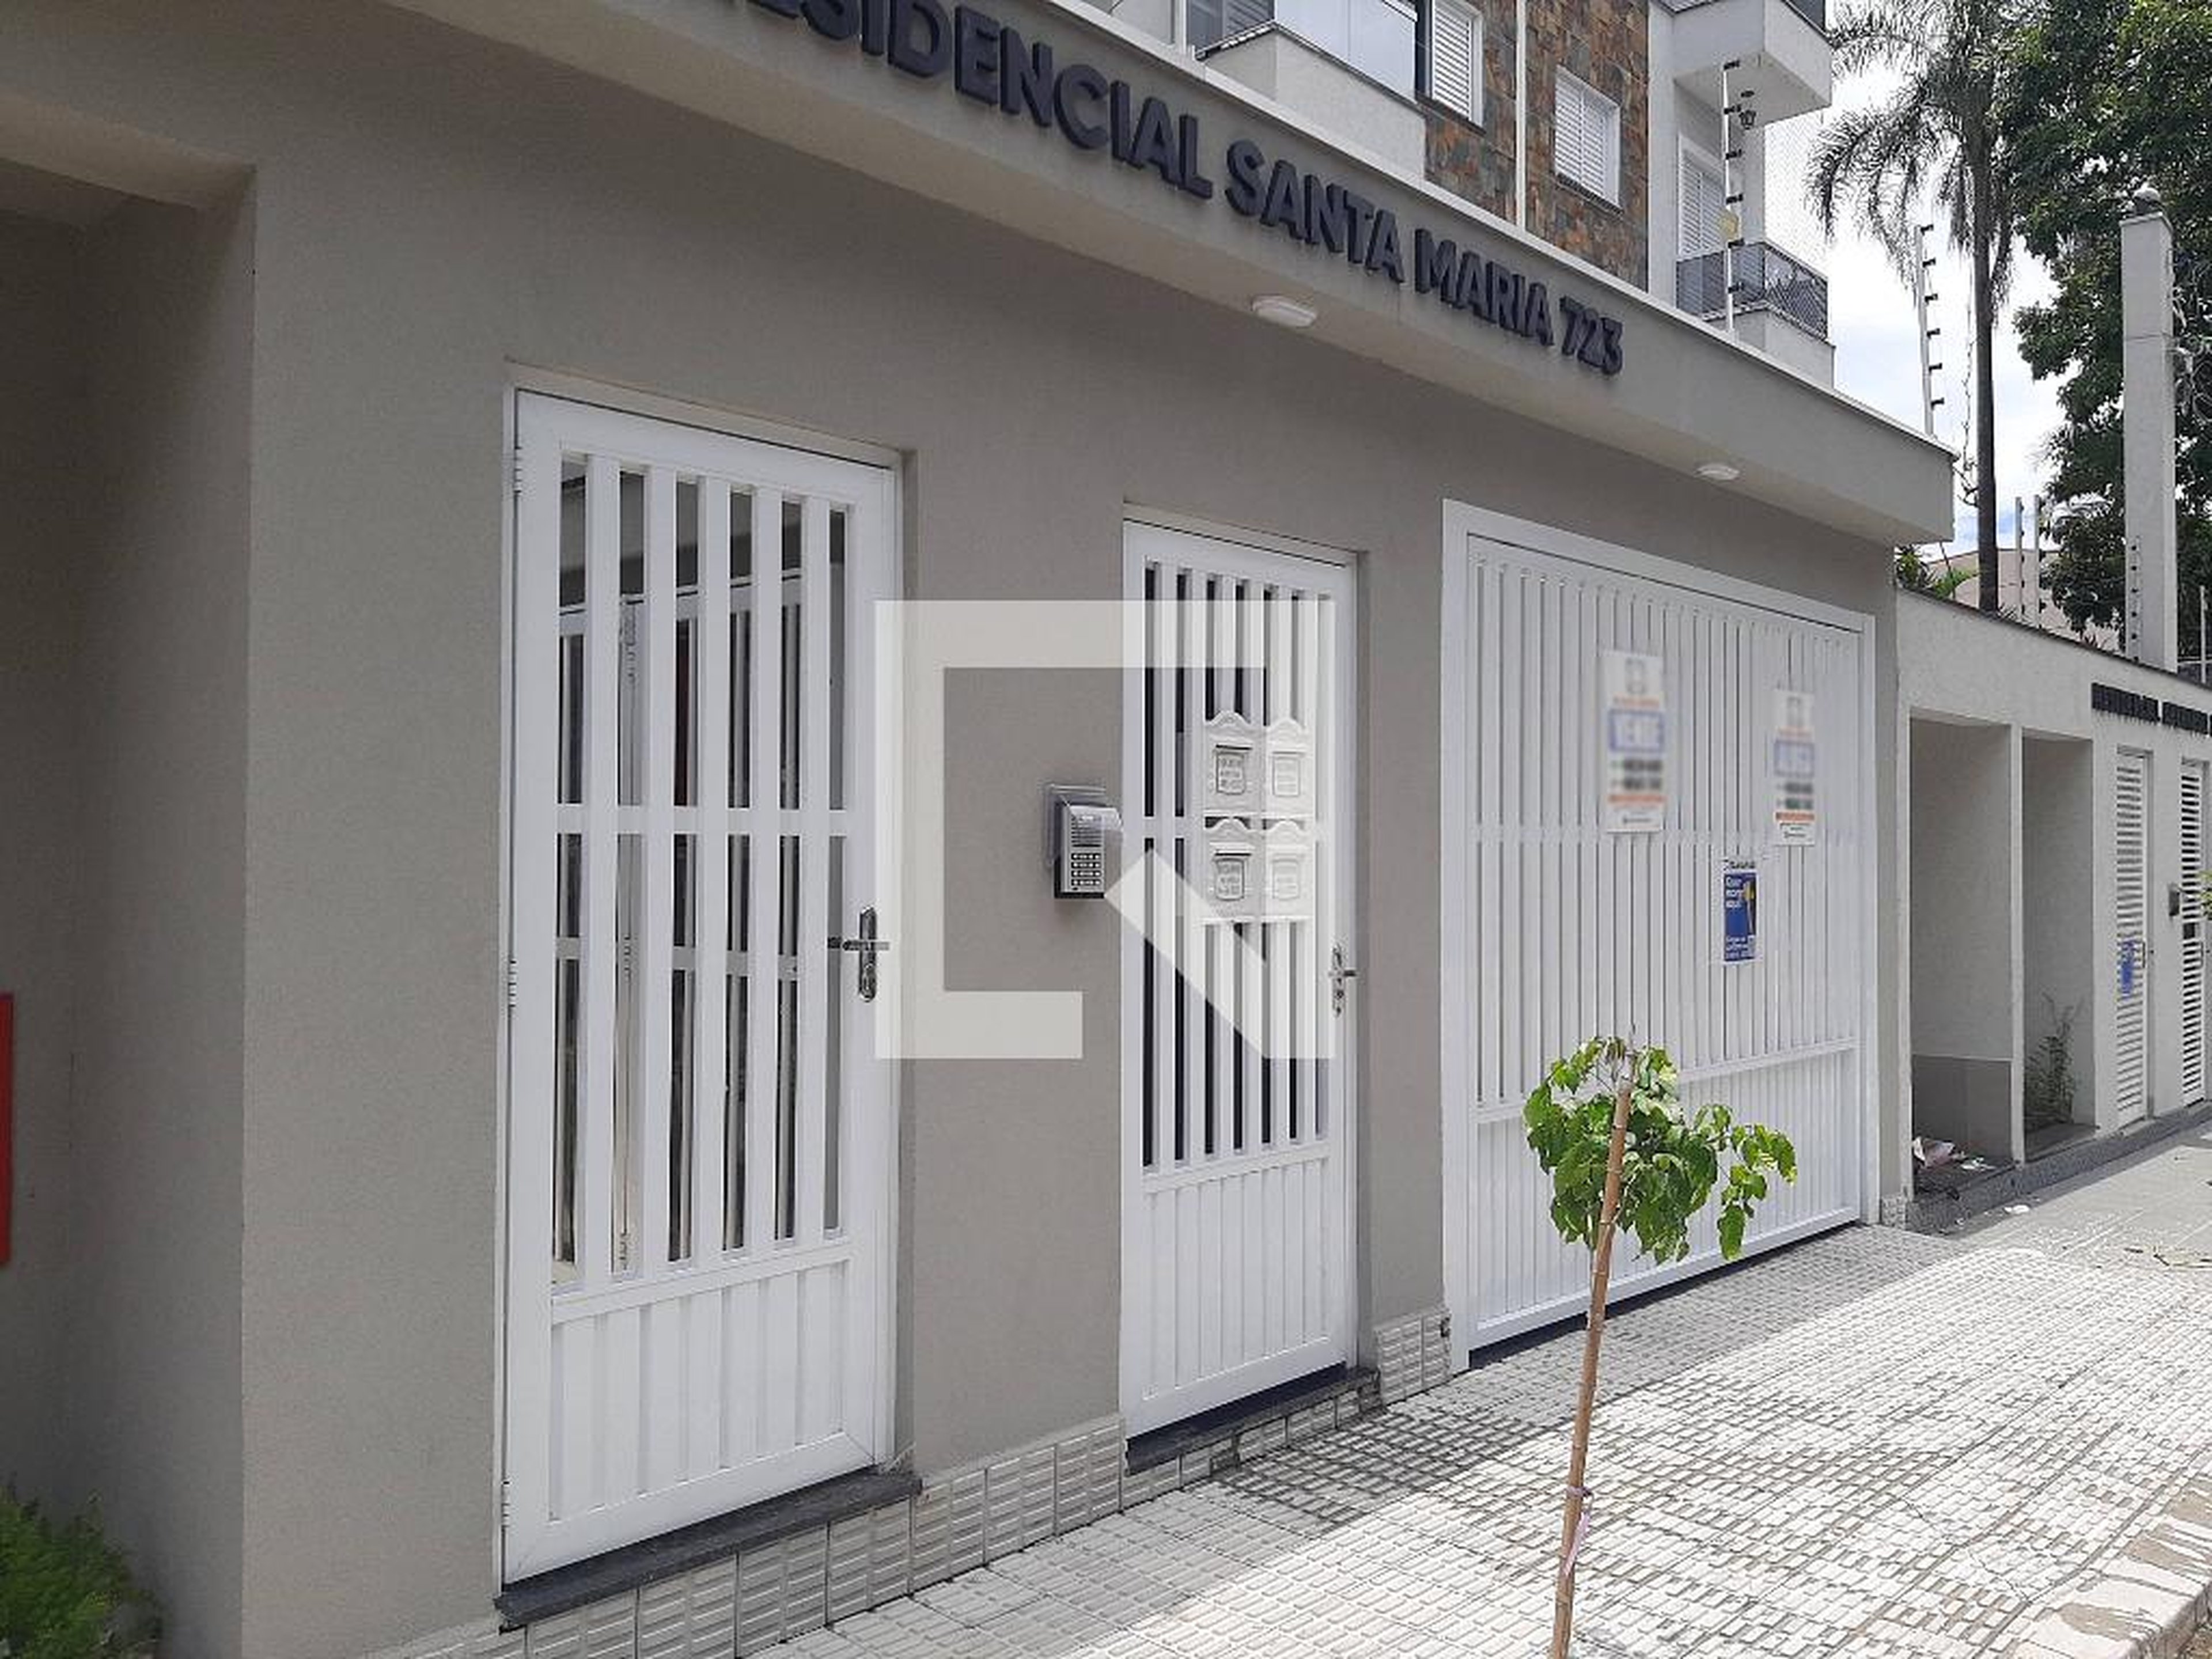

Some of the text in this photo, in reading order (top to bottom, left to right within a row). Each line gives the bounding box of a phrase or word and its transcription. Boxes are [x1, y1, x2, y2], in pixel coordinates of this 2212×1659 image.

[740, 0, 1624, 376] IDENCIAL SANTA MARIA 723
